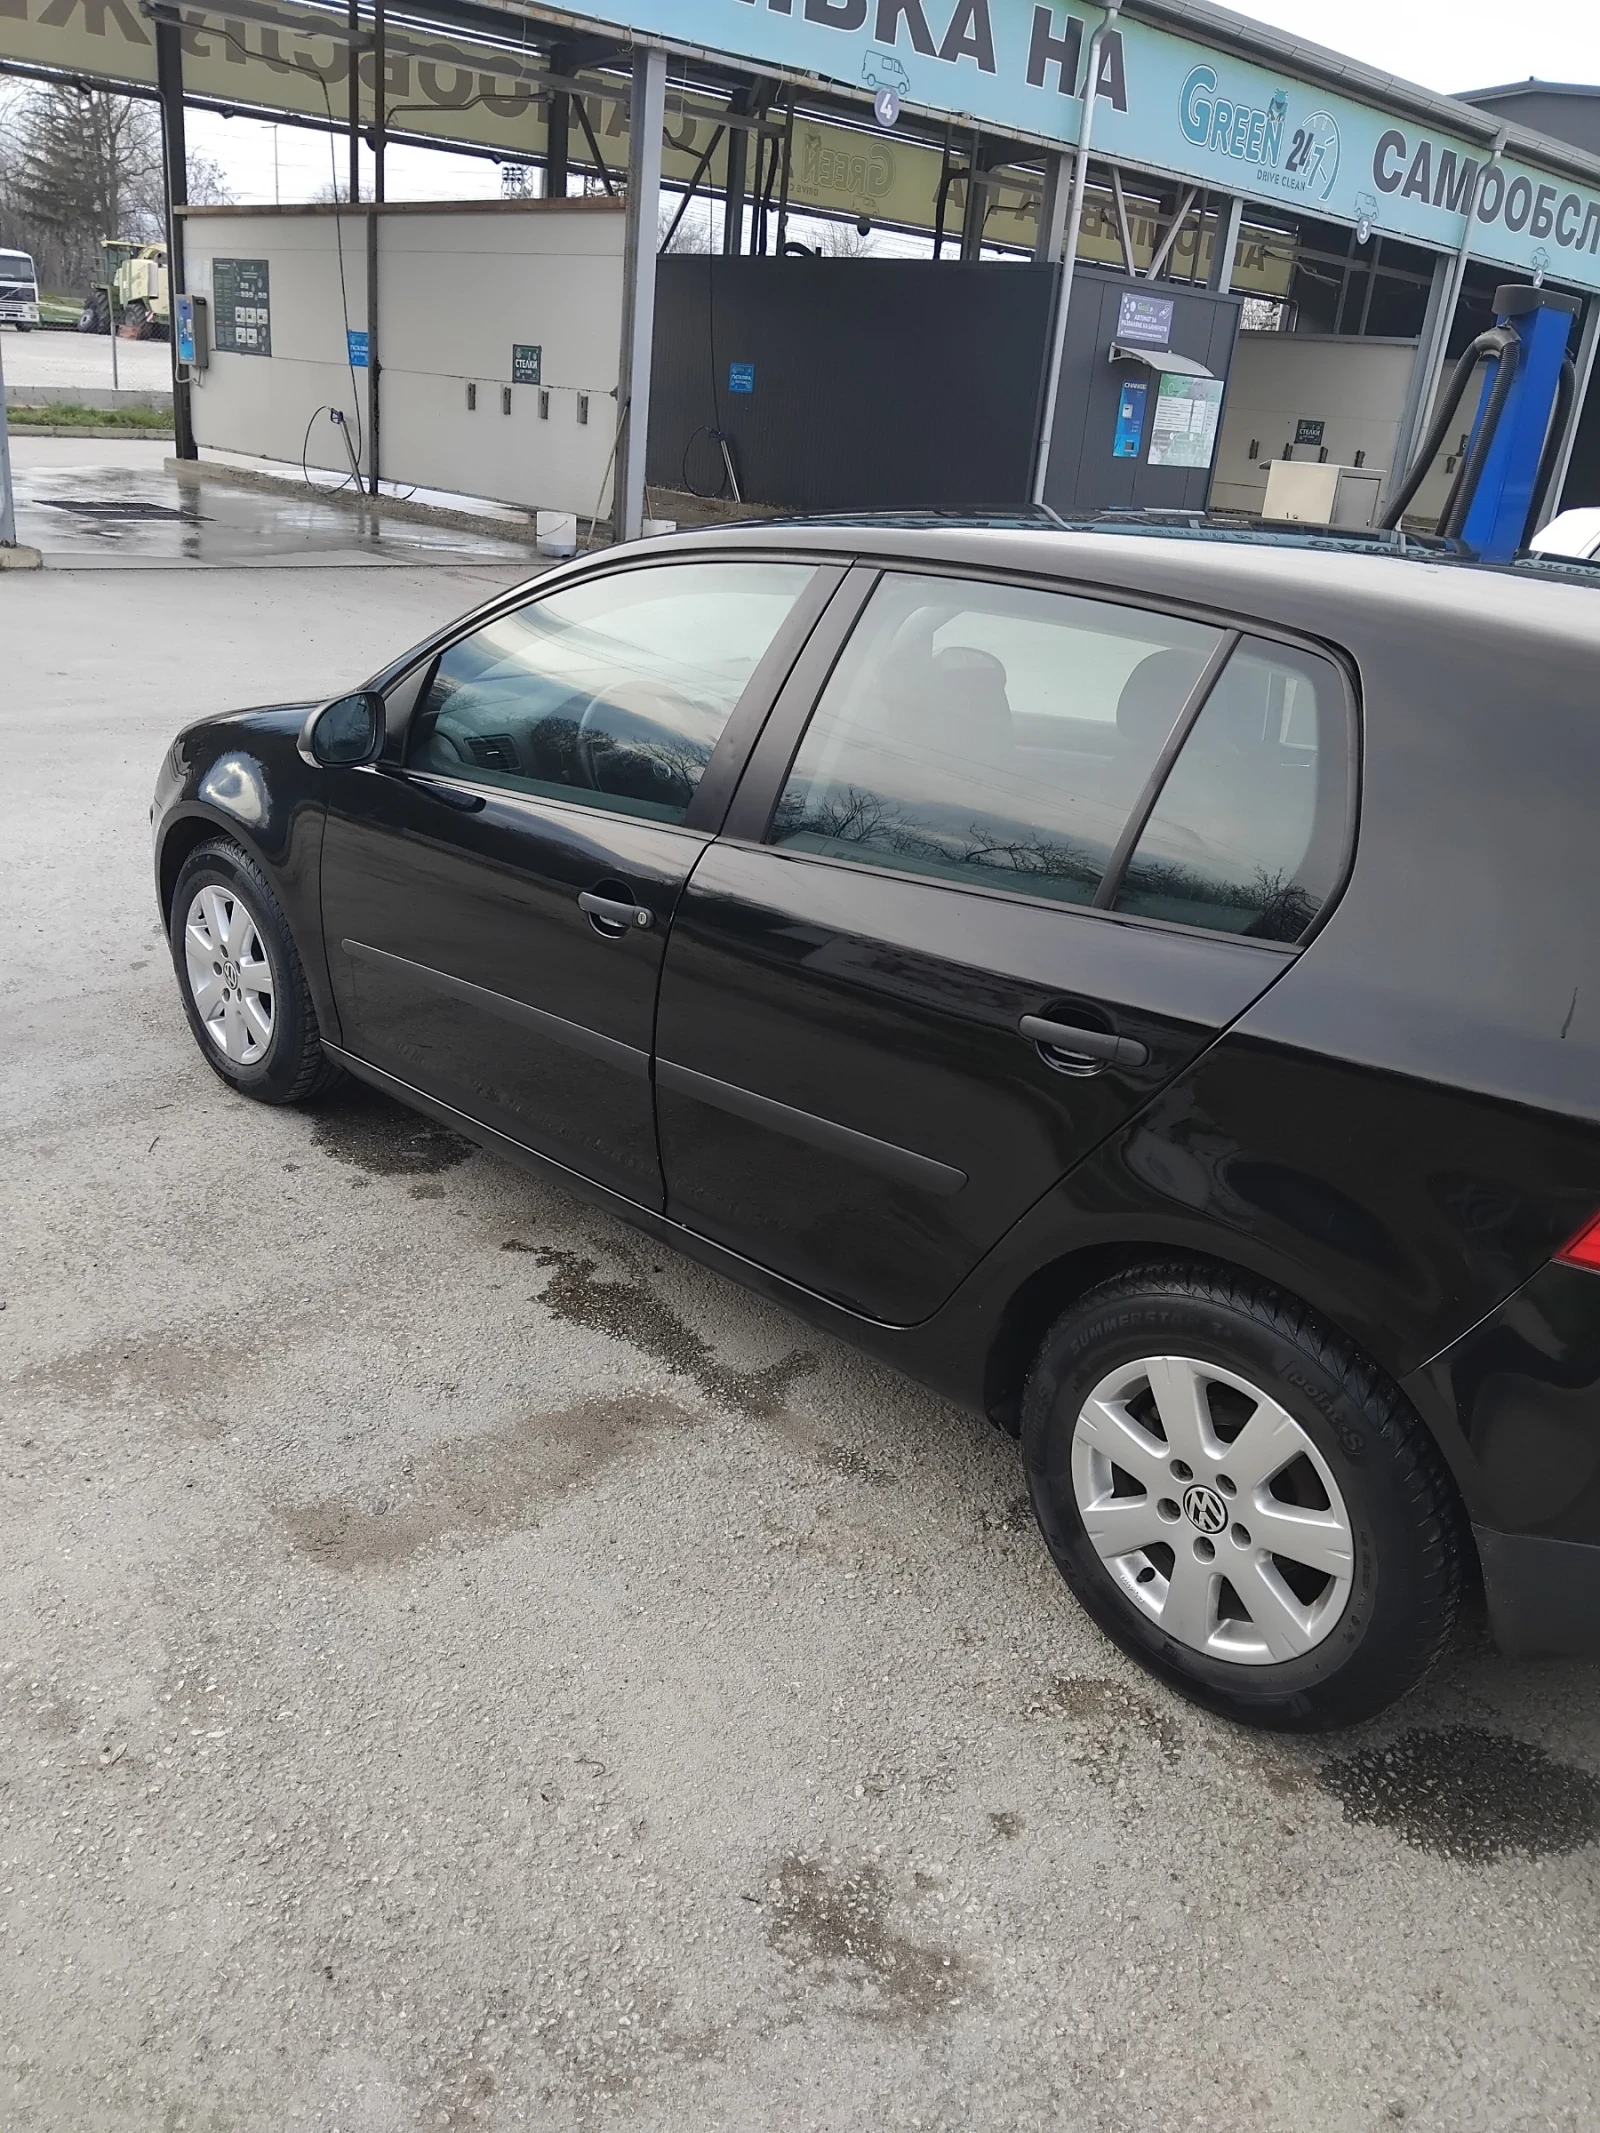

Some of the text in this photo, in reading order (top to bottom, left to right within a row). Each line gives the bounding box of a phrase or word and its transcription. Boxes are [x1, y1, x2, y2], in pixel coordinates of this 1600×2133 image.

[1024, 3, 1129, 114] НА
[879, 93, 893, 119] 4
[1256, 169, 1306, 192] DRIVE CLEAN
[1359, 218, 1370, 240] 3
[1535, 269, 1543, 286] 2
[1124, 382, 1148, 390] CHANGE
